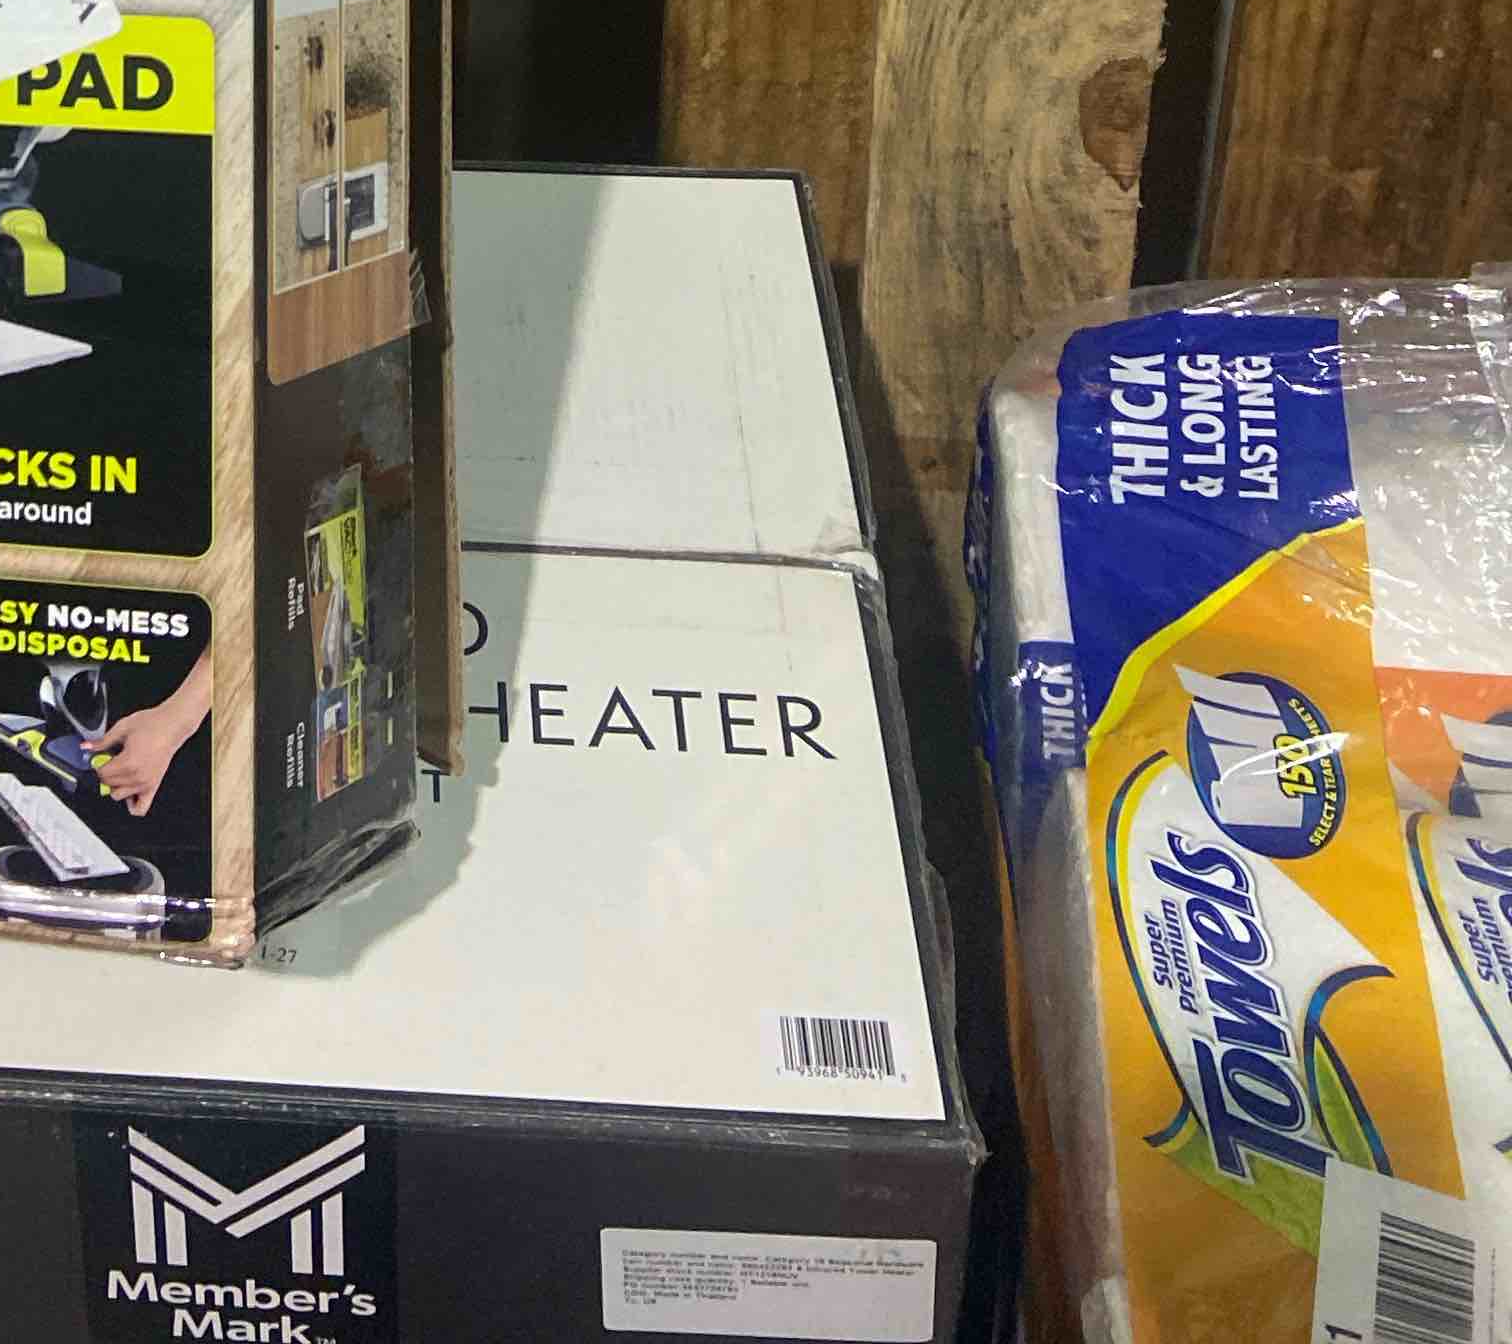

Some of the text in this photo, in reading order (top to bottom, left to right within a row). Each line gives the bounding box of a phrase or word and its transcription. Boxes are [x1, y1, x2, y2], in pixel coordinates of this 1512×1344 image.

[16, 53, 175, 111] PAD
[1108, 352, 1169, 505] THICK
[1177, 353, 1226, 499] & LONG
[1238, 354, 1280, 501] LASTING
[89, 455, 138, 494] IN
[47, 607, 190, 638] NO-MESS
[1040, 661, 1074, 760] THICK
[1288, 698, 1321, 736] HEETS
[1273, 734, 1318, 798] 150
[1319, 758, 1336, 789] TEAR
[1308, 801, 1337, 847] SELECT
[107, 1270, 377, 1316] Member's
[172, 1308, 311, 1344] Mark
